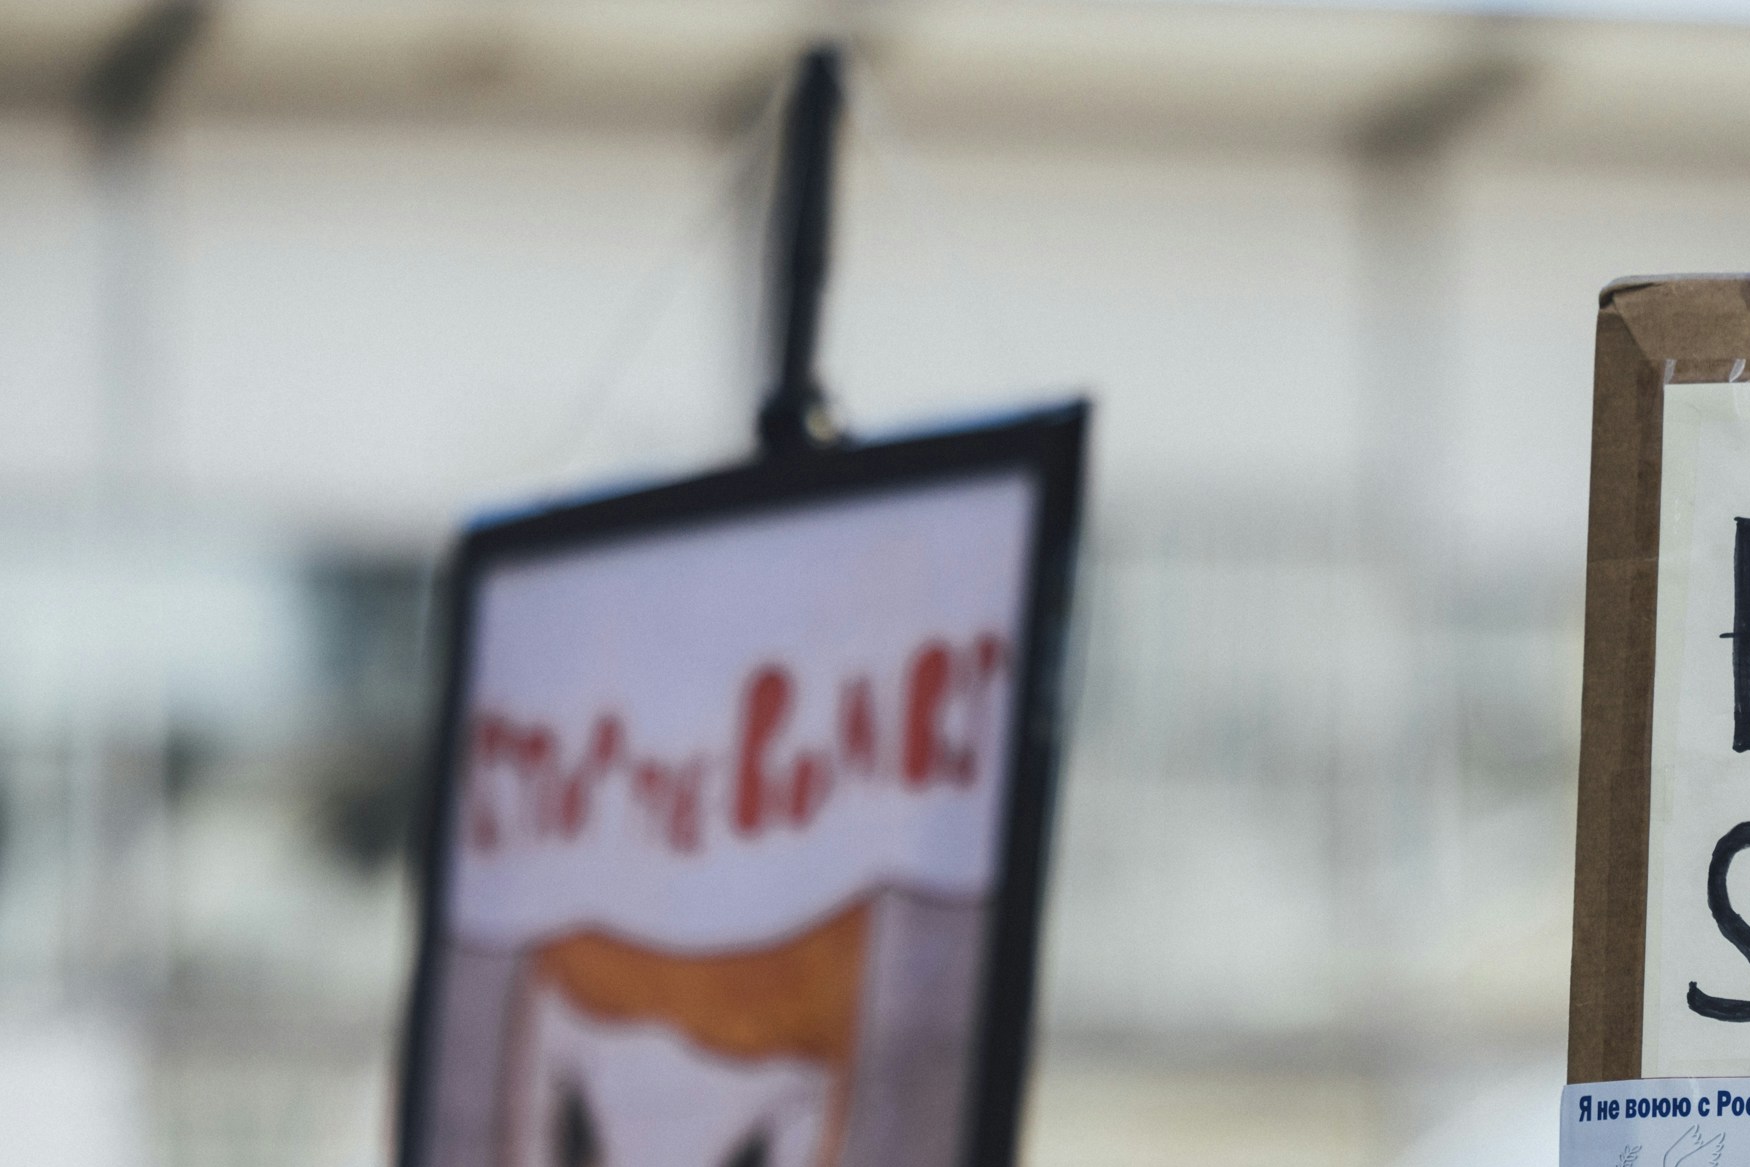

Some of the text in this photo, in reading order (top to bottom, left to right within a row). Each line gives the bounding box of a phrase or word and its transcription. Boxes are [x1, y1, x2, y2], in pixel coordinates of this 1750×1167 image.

[1578, 1094, 1593, 1122] Я
[1597, 1098, 1621, 1121] не
[1625, 1096, 1692, 1119] воюю
[1697, 1096, 1711, 1118] с
